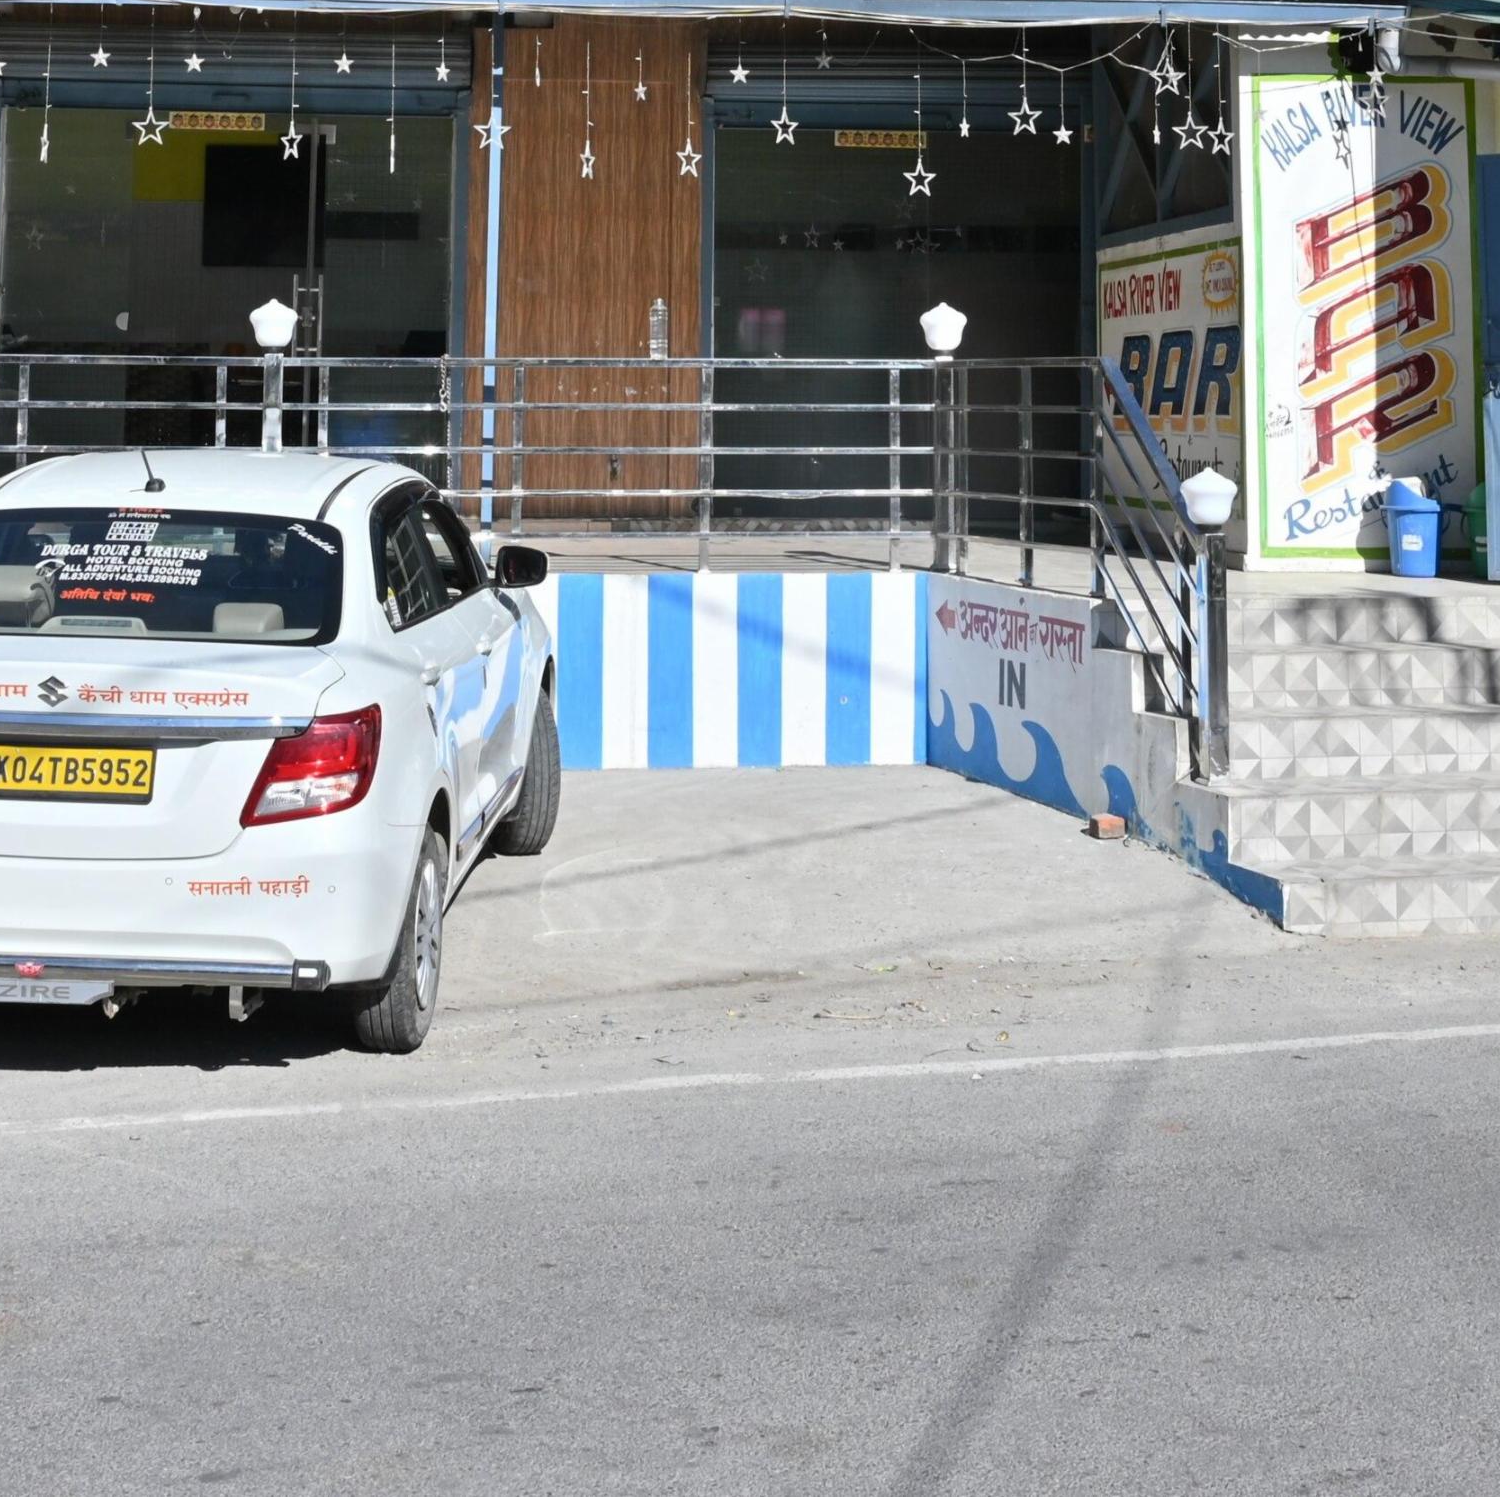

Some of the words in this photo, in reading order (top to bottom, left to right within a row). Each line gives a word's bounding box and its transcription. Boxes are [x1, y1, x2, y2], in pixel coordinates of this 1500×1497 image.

[1260, 101, 1323, 172] KALSA
[1320, 84, 1385, 129] RIVER
[1398, 89, 1466, 156] VIEW
[1103, 278, 1128, 321] KALSA
[1129, 272, 1155, 316] RIVER
[1158, 263, 1181, 313] VIEW
[1112, 324, 1242, 418] BAR
[41, 544, 90, 557] DURGA
[92, 544, 131, 557] TOUR
[144, 546, 209, 561] TRAVELS
[85, 556, 125, 565] HOTEL
[127, 557, 184, 568] BOOKING
[62, 563, 82, 572] ALL
[84, 564, 150, 574] ADVENTURE
[151, 567, 202, 577] BOOKING
[60, 587, 100, 600] अतिथि
[103, 588, 128, 601] देवो
[998, 657, 1027, 711] IN
[77, 684, 121, 704] कैंची
[129, 690, 166, 705] धाम
[174, 689, 250, 710] एक्सप्रेस
[187, 876, 251, 897] सनातनी
[257, 875, 310, 898] पहाड़ी
